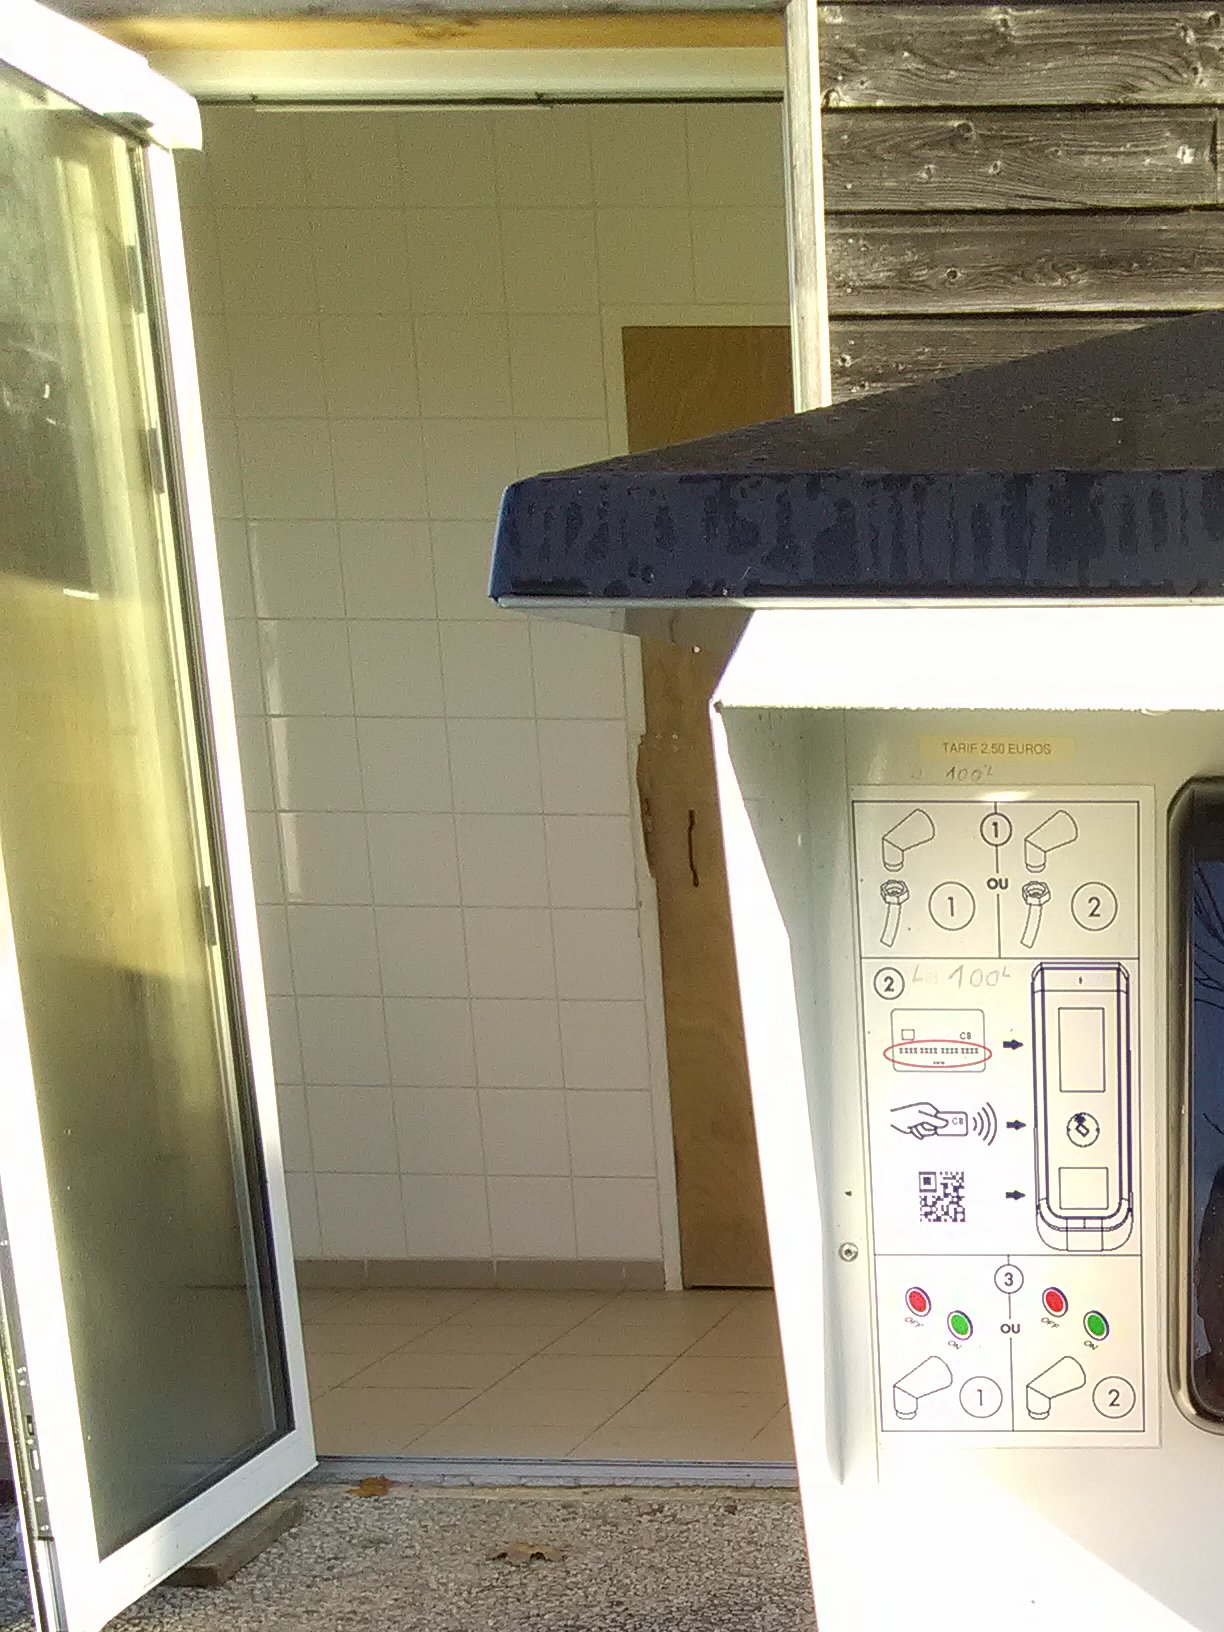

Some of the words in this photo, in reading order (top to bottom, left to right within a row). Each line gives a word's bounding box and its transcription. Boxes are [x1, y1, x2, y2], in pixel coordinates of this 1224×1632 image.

[943, 742, 978, 754] TARIF
[980, 743, 1005, 755] 2.50
[1008, 743, 1052, 755] EUROS
[986, 878, 1009, 890] OU
[1088, 897, 1101, 917] 2
[904, 1316, 924, 1329] OFF
[1000, 1323, 1021, 1335] OU
[1041, 1316, 1060, 1329] OFF
[948, 1340, 963, 1350] ON
[1083, 1340, 1099, 1350] ON
[1108, 1389, 1121, 1407] 2
